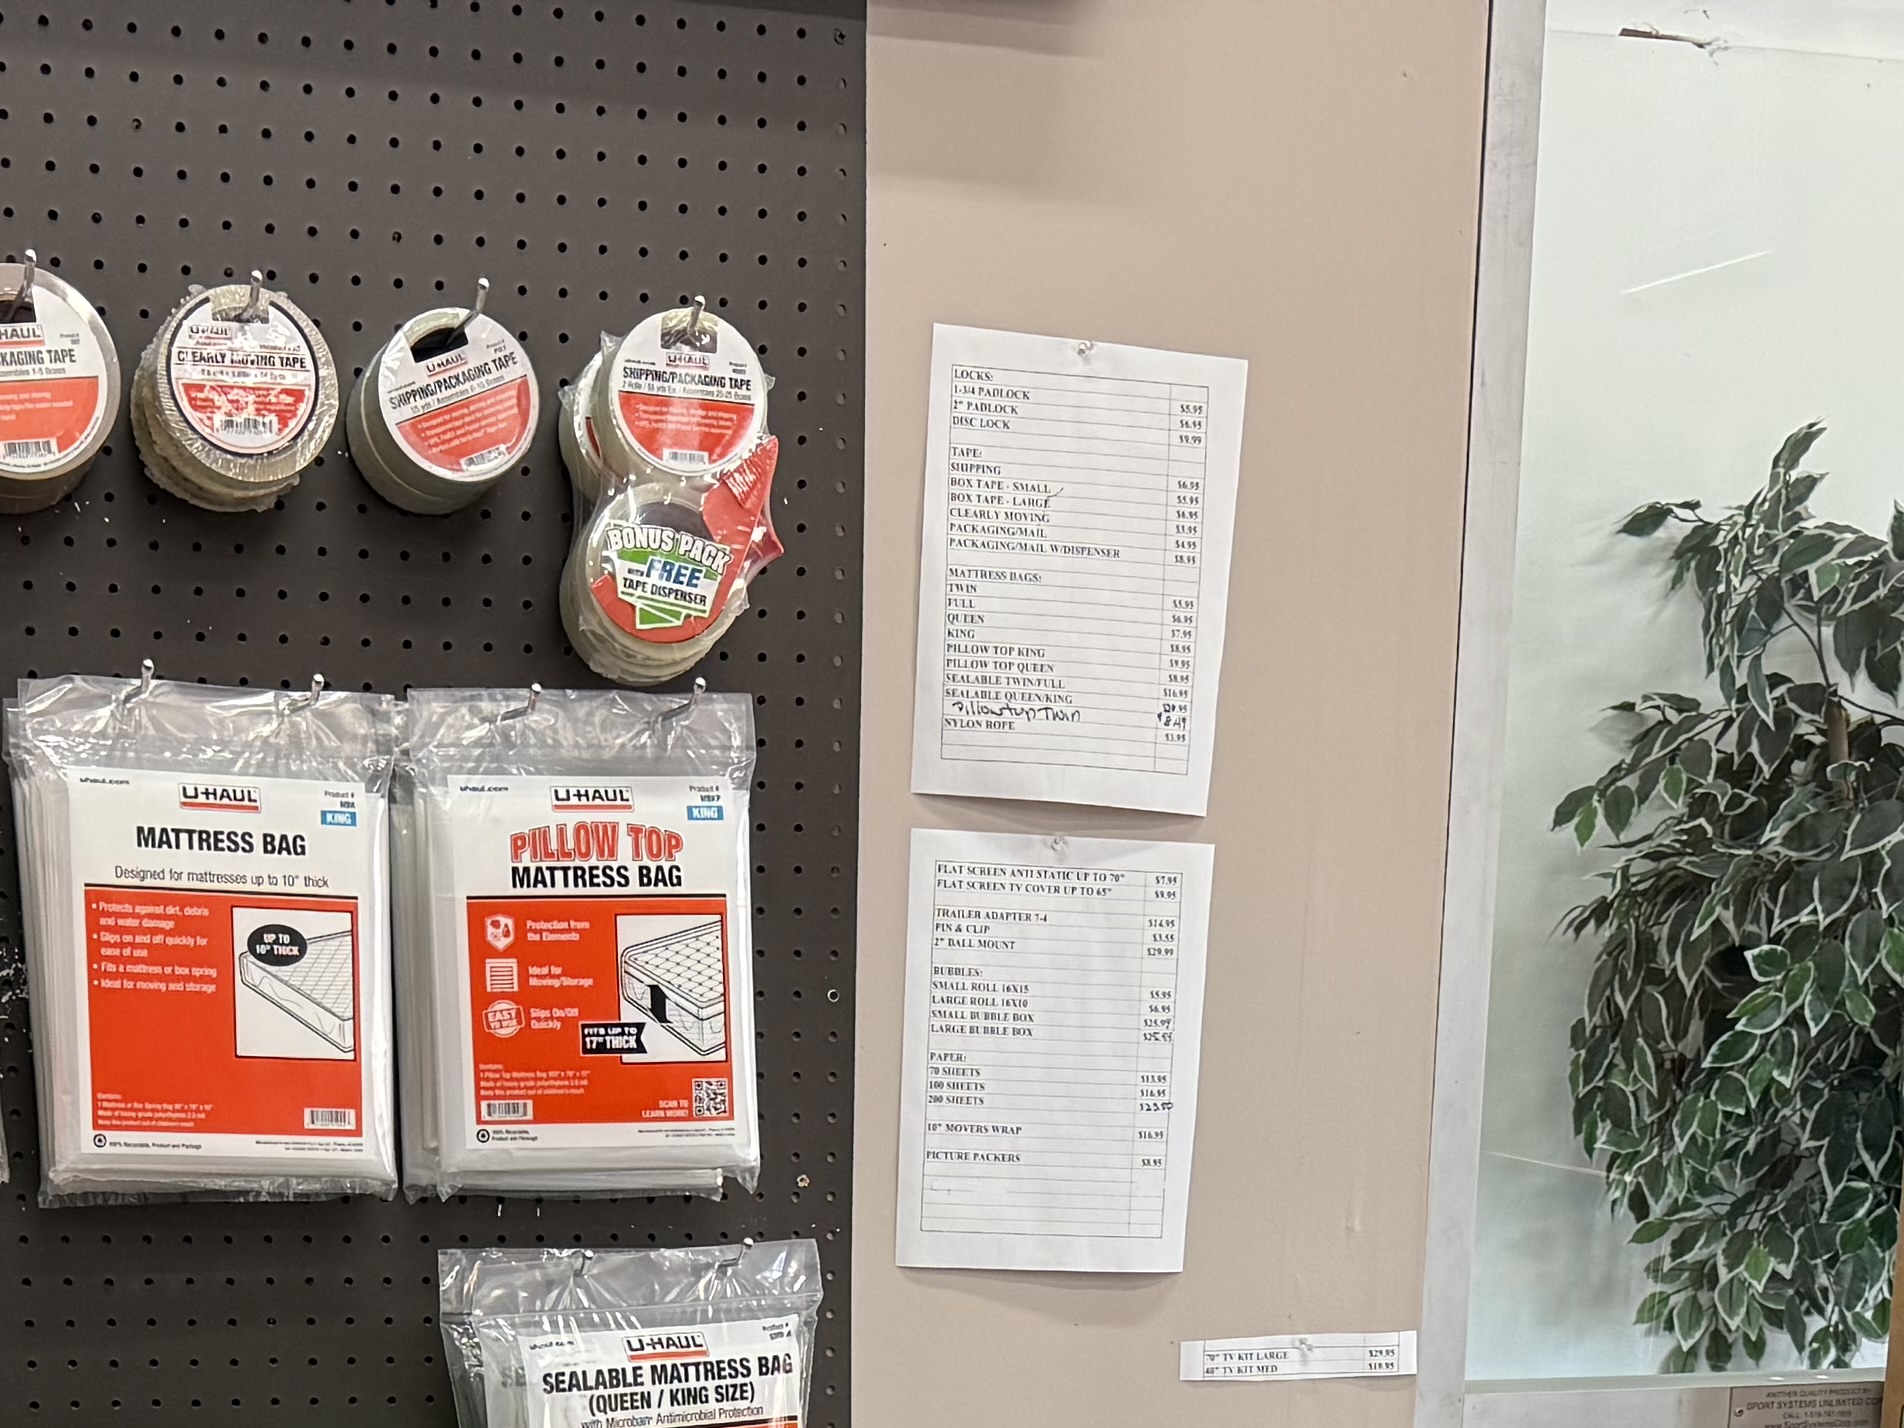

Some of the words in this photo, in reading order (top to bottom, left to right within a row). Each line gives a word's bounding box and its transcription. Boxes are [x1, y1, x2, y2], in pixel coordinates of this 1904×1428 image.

[623, 367, 726, 388] SHIPPING/PACKAGING
[728, 377, 751, 391] TAPE
[950, 462, 1001, 475] SHIPPING
[607, 528, 675, 549] BONUS
[678, 533, 732, 573] PACK
[646, 556, 704, 588] FREE
[623, 577, 648, 593] TAPE
[651, 582, 707, 606] DISPENSER
[947, 612, 985, 624] QUEEN
[510, 822, 621, 862] PILLOW
[627, 823, 684, 861] TOP
[511, 865, 630, 889] MATTRESS
[638, 866, 682, 888] BAG
[1238, 1353, 1253, 1361] KIT
[1256, 1351, 1289, 1360] LARGE
[542, 1366, 645, 1394] SEALABLE
[650, 1357, 751, 1387] MATTRESS
[758, 1354, 793, 1377] BAG
[589, 1389, 652, 1416] (QUEEN
[669, 1385, 709, 1408] KING
[714, 1381, 755, 1405] SIZE)
